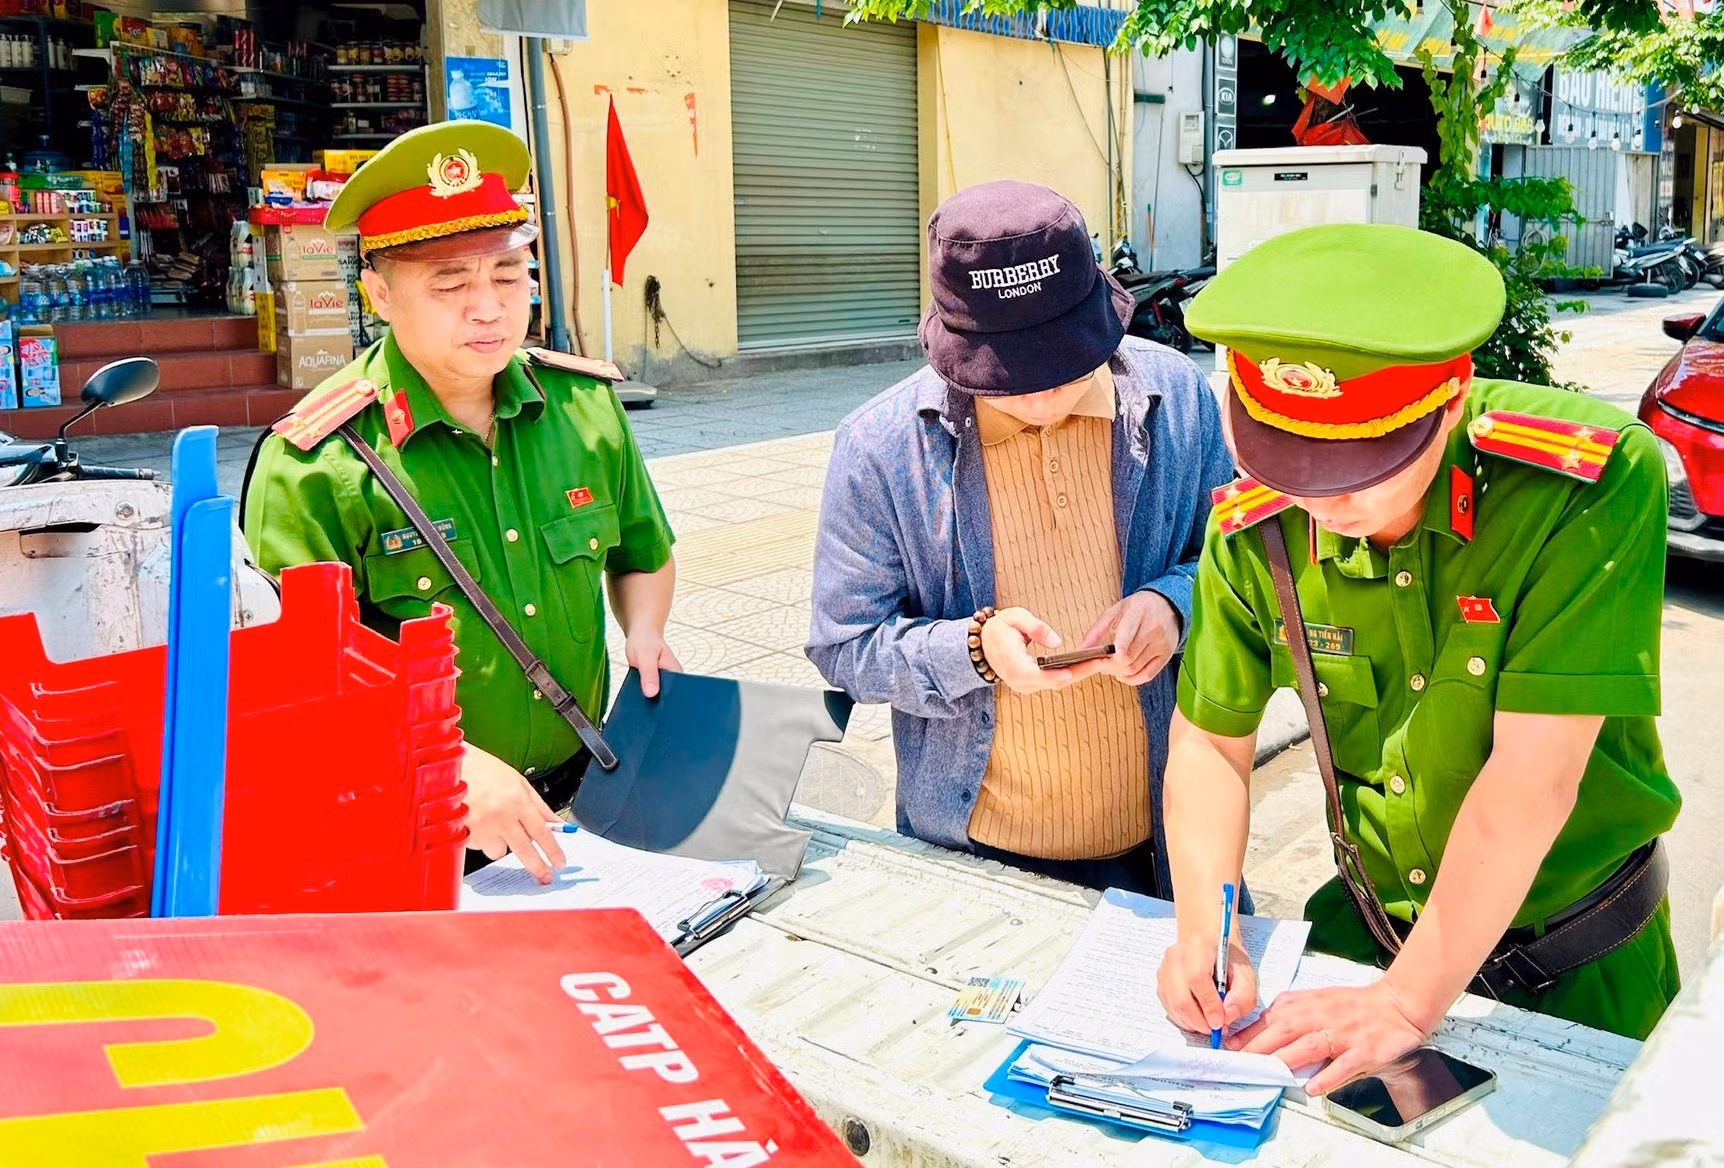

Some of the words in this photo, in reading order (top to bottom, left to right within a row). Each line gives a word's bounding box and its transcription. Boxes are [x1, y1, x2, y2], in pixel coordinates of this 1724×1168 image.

[1220, 91, 1233, 102] KIA
[968, 254, 1060, 289] BURBERRY
[998, 282, 1042, 299] LONDON
[298, 354, 347, 369] AQUAFINA
[559, 971, 699, 1084] CATP
[657, 1098, 779, 1168] HÀ
